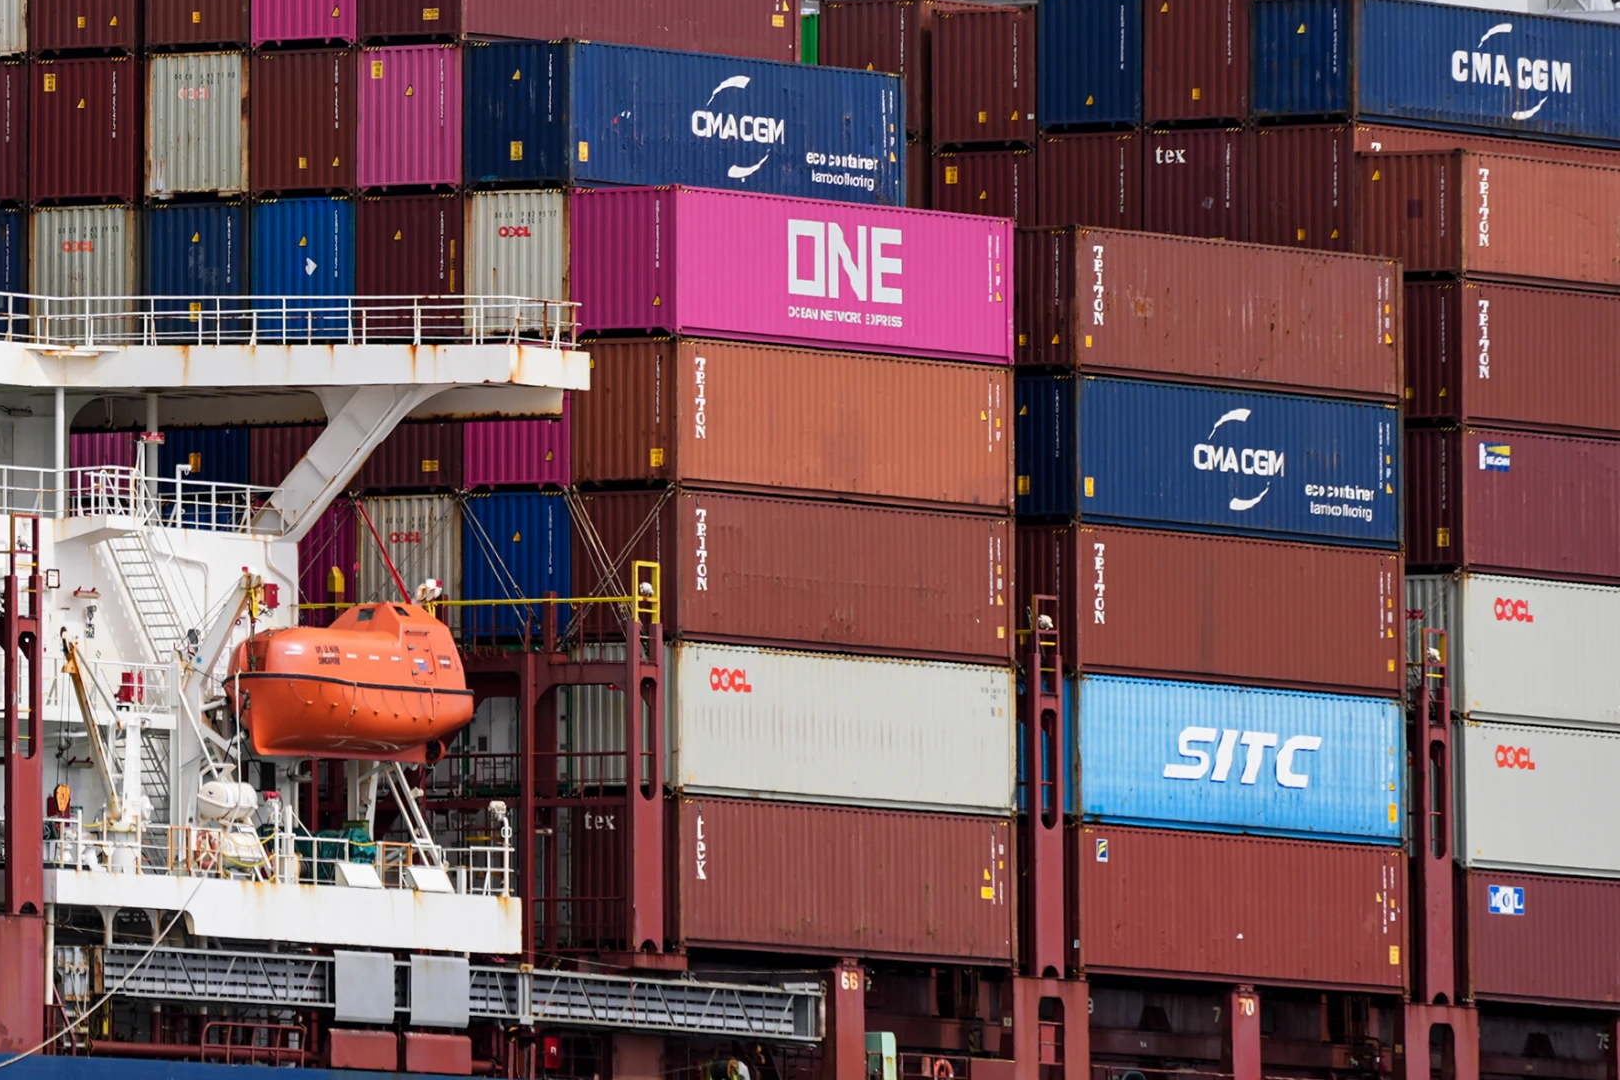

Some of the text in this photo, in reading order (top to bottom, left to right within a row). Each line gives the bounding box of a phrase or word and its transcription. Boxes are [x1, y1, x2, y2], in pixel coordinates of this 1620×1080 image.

[1452, 51, 1571, 93] CMA CGM
[692, 111, 784, 144] CMA CGM
[806, 151, 879, 170] eco container
[1155, 146, 1186, 164] tex
[1478, 168, 1490, 247] TRITON
[499, 226, 531, 238] OOCL
[61, 240, 94, 253] OOCL
[788, 219, 903, 305] ONE
[1092, 245, 1104, 326] TRITON
[788, 305, 903, 328] OCEAN NETWORK EXPRESS
[1478, 299, 1490, 379] TRITON
[694, 357, 706, 439] TRITON
[1194, 444, 1284, 476] CMA CGM
[1305, 484, 1375, 501] eco container
[695, 508, 708, 591] TRITON
[1093, 542, 1106, 625] TRITON
[1495, 597, 1534, 623] OOCL
[710, 667, 752, 693] OOCL
[1164, 726, 1322, 787] SITC
[1496, 744, 1536, 771] OOCL
[584, 812, 615, 830] tex
[696, 815, 707, 880] tex
[1490, 891, 1524, 909] MOL
[841, 971, 859, 990] 66
[1238, 998, 1255, 1016] 70
